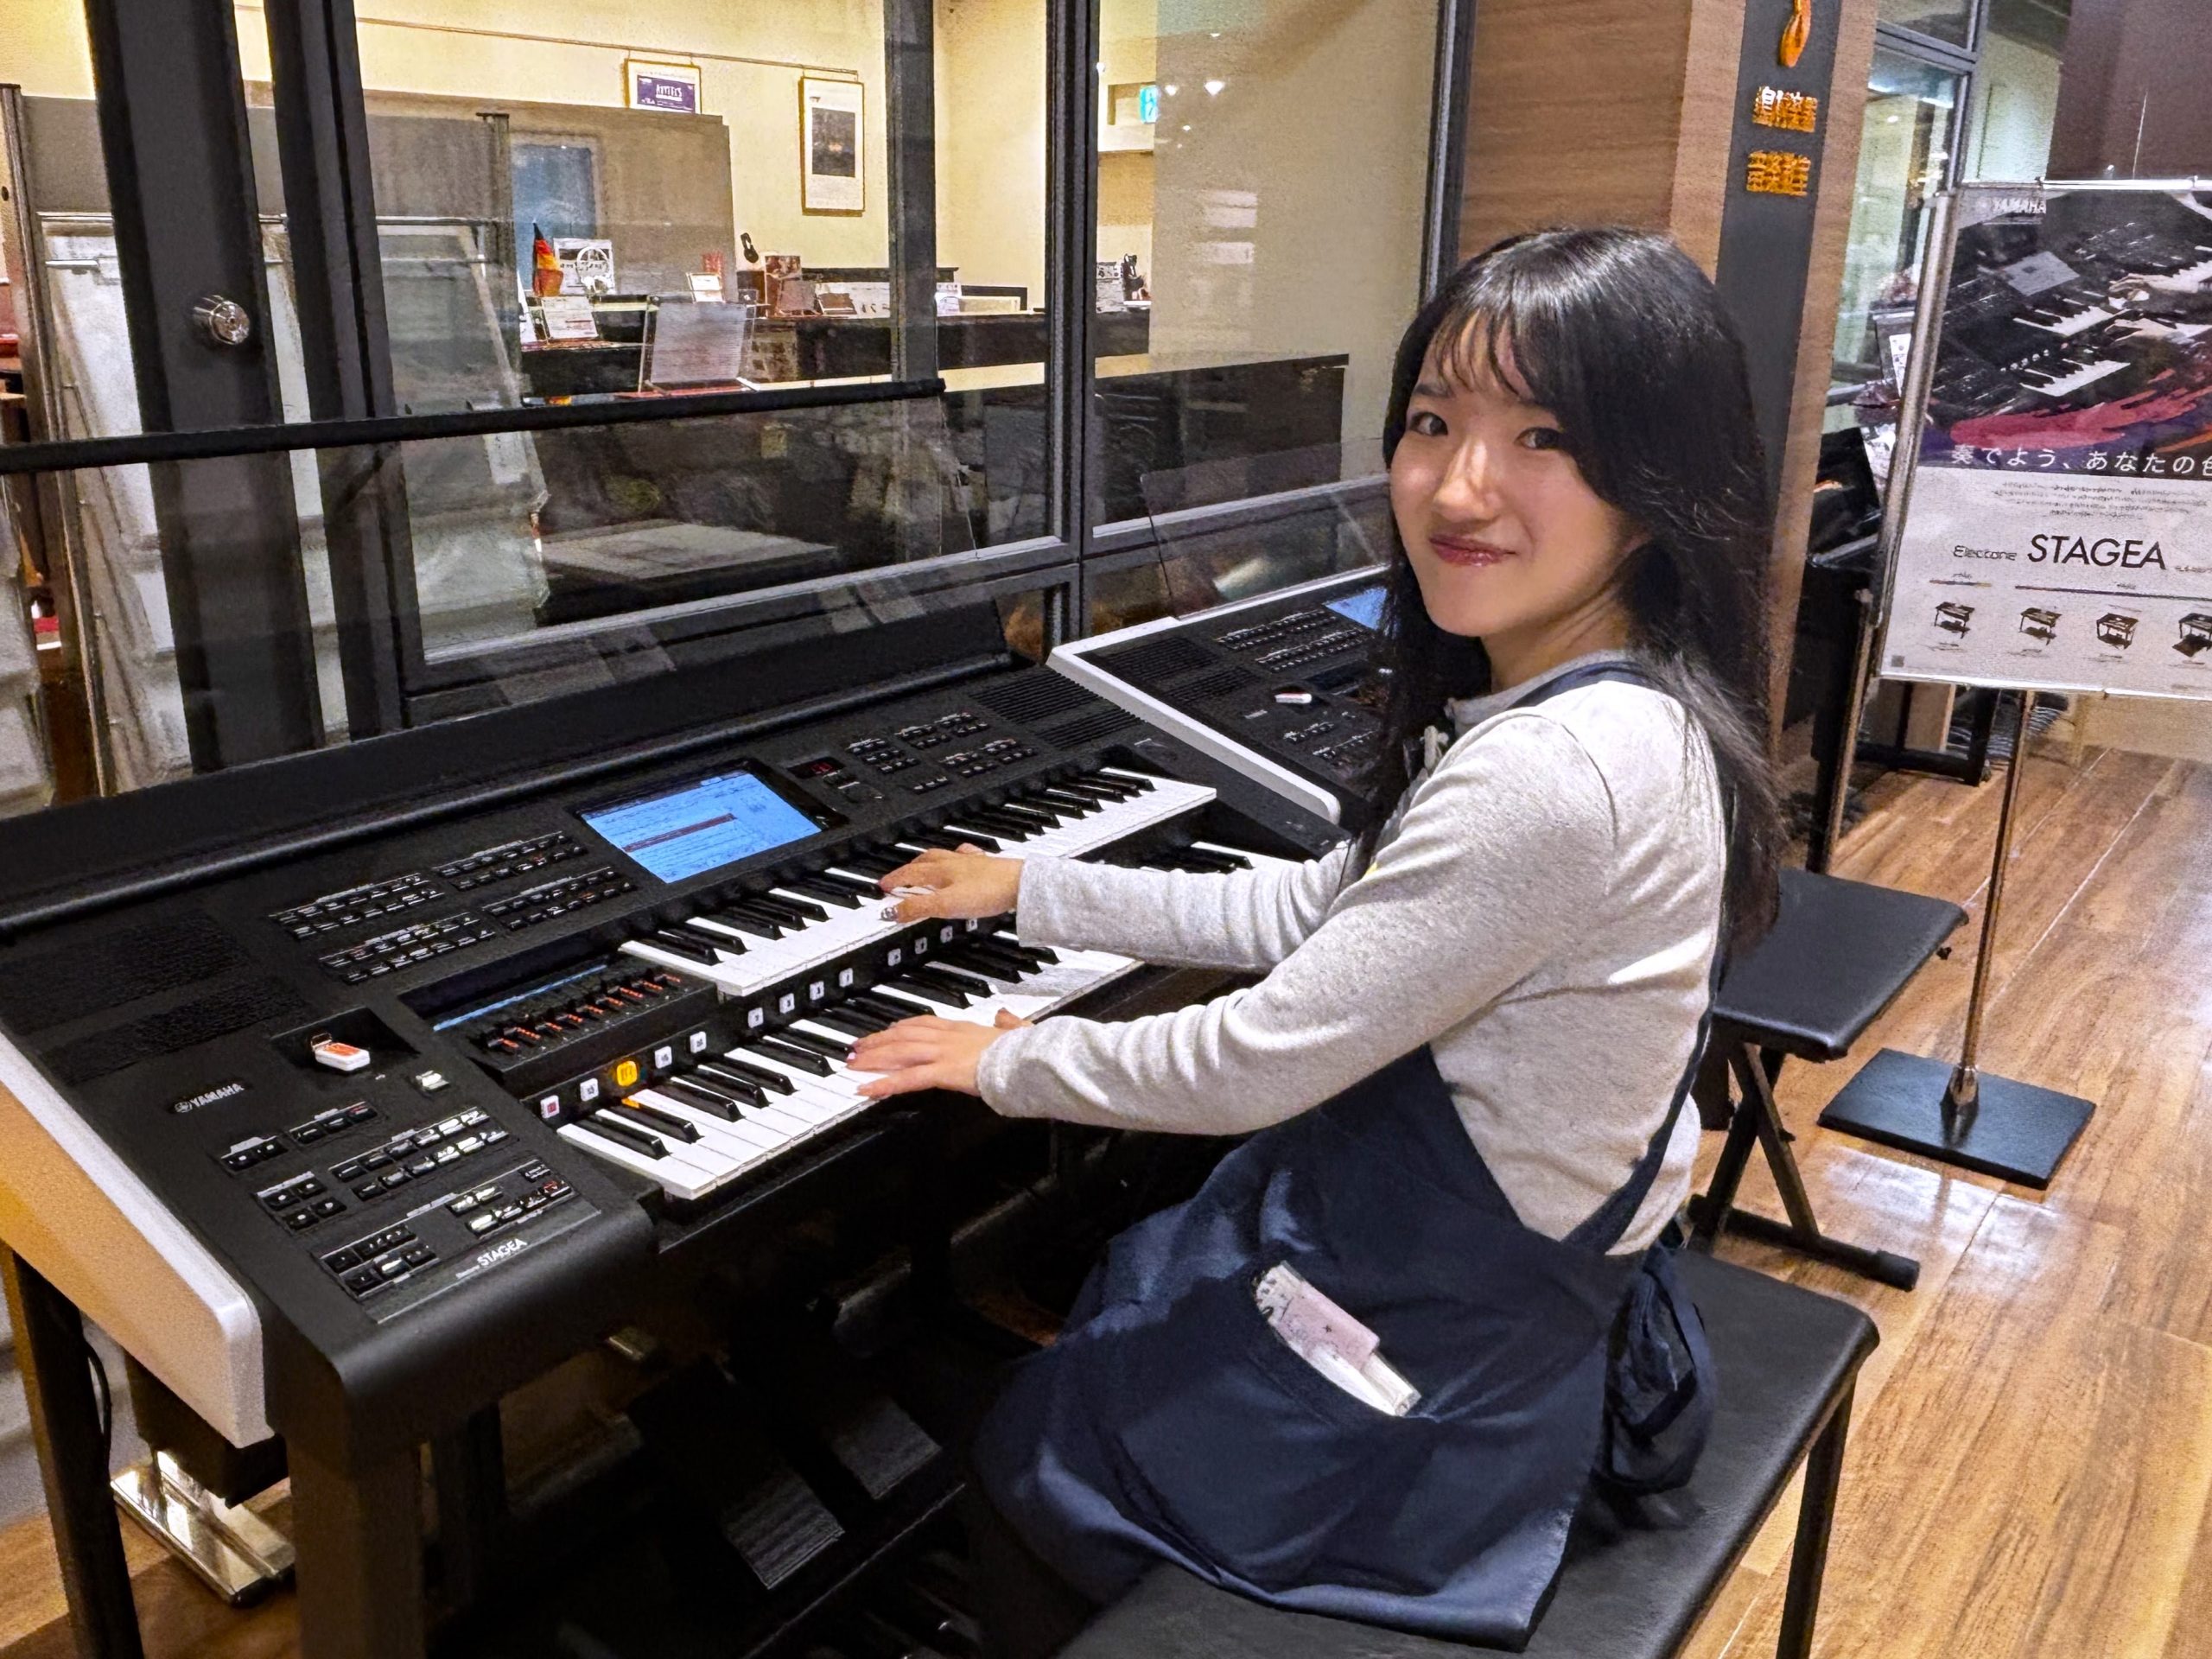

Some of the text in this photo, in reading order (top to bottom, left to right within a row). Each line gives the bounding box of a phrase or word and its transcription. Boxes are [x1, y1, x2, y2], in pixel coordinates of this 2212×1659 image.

[2027, 534, 2166, 570] STAGEA
[189, 1083, 245, 1107] YAMAHA
[477, 1238, 528, 1266] STAGEA
